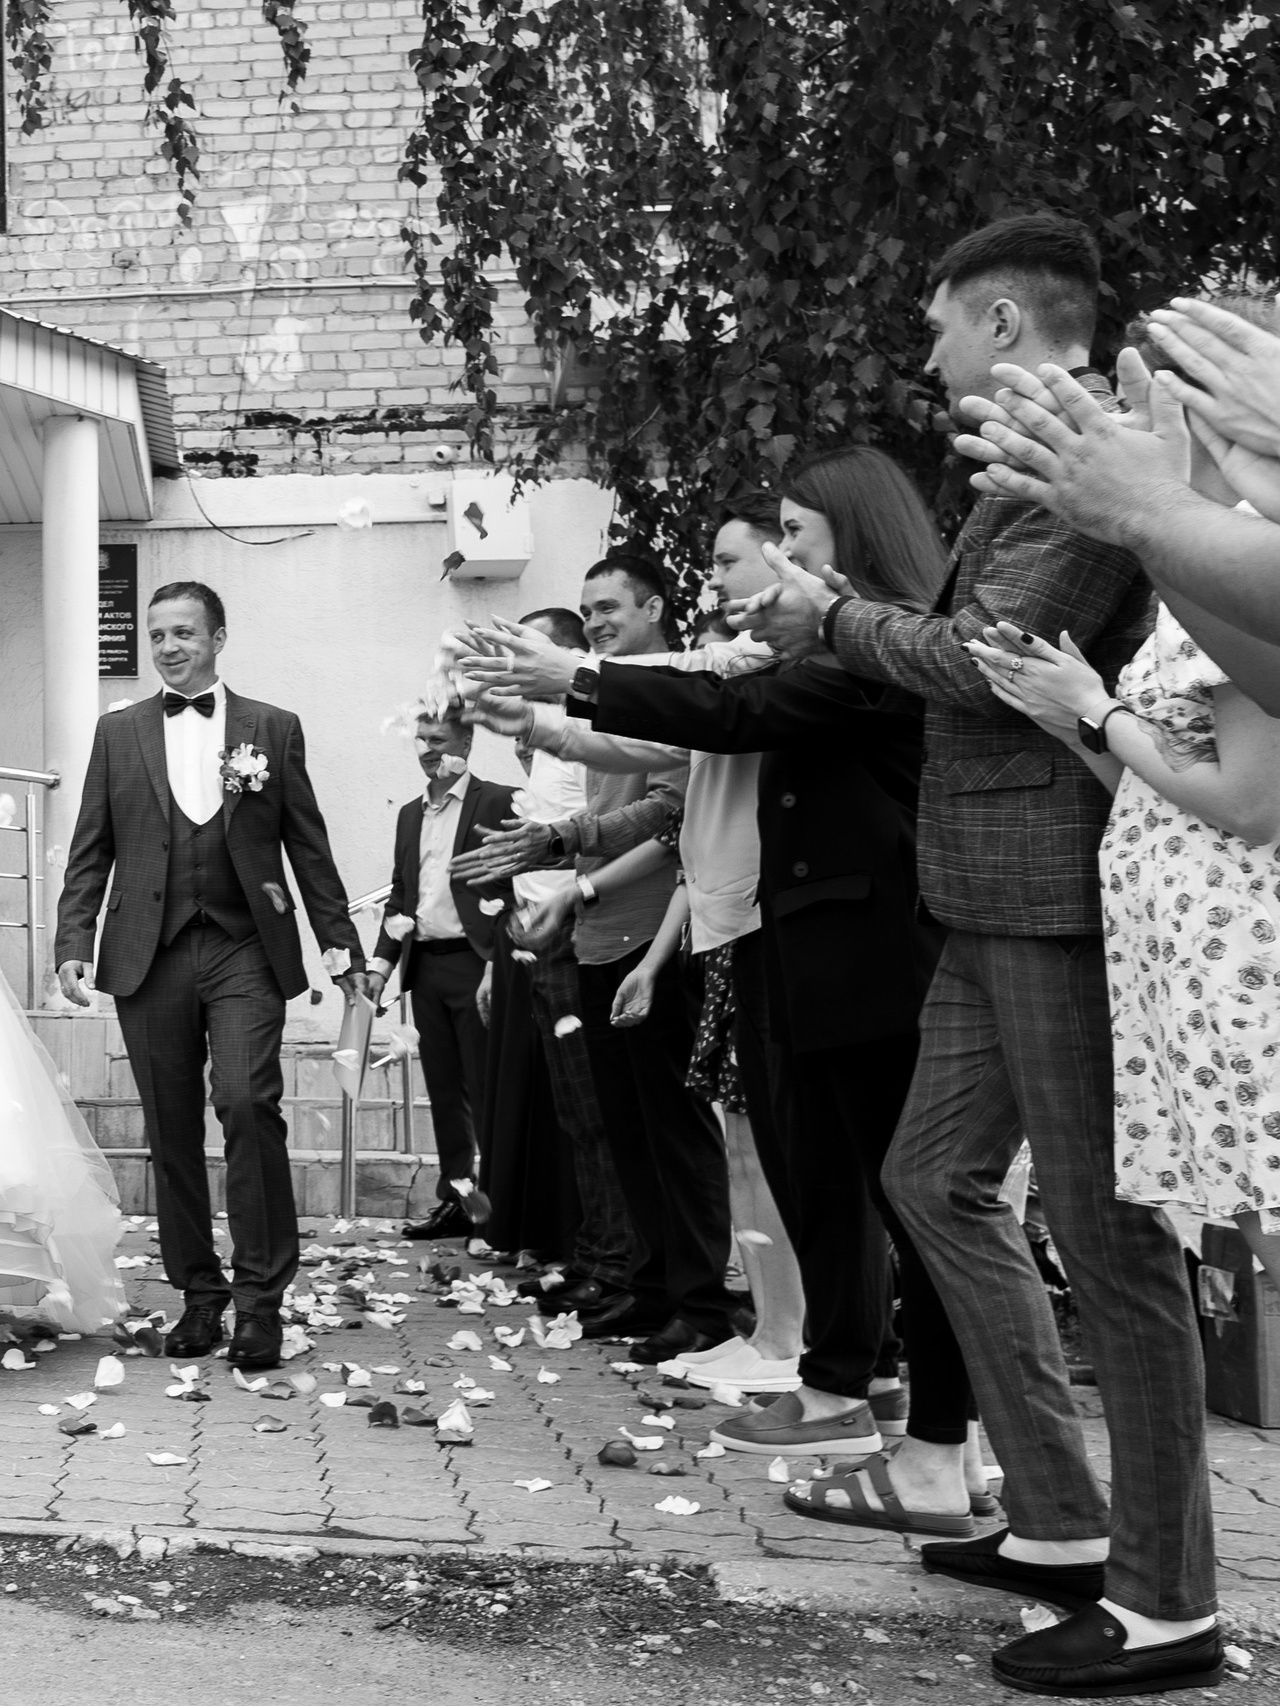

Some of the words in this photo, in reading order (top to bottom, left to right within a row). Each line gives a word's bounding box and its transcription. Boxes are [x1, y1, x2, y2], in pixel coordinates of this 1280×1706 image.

[99, 600, 114, 608] ДЕЛ
[104, 611, 132, 619] АКТОВ
[99, 634, 126, 643] ОЯНИЯ
